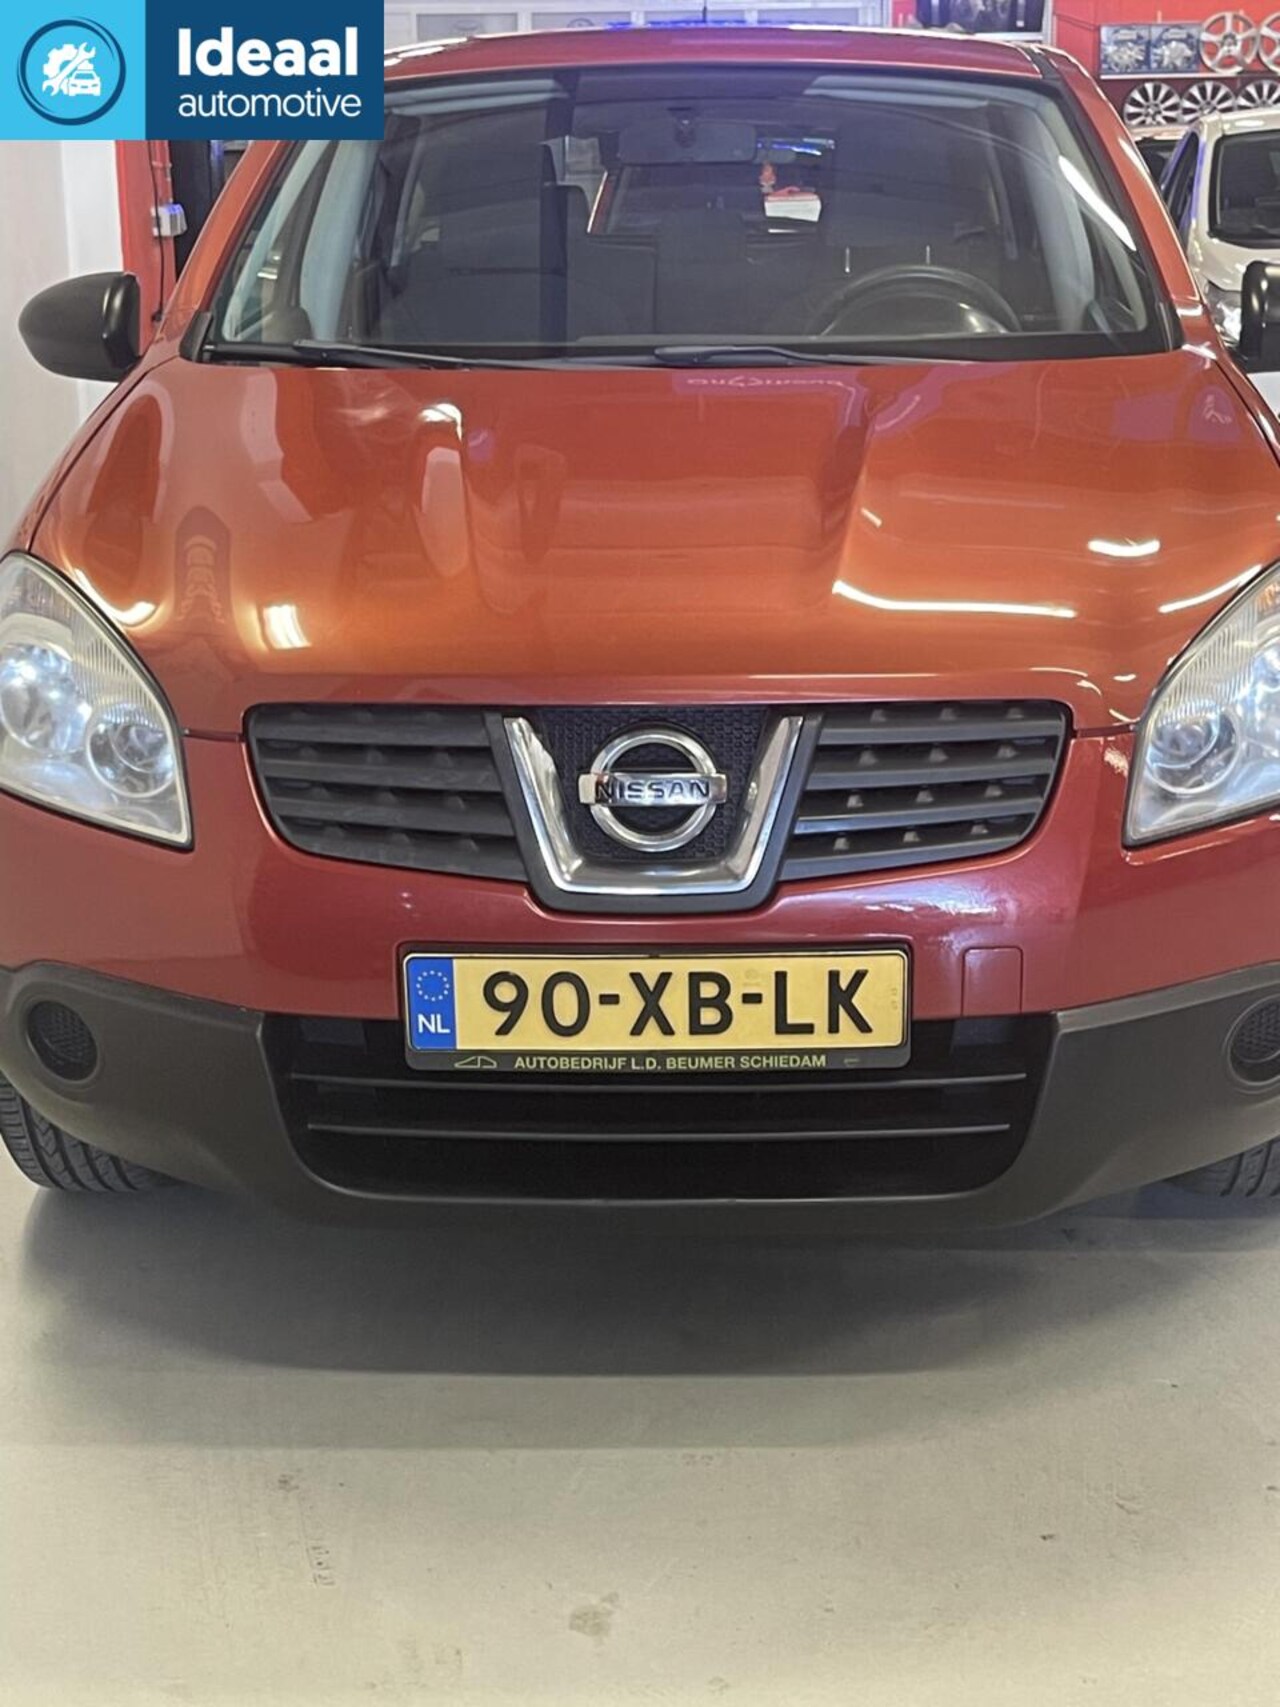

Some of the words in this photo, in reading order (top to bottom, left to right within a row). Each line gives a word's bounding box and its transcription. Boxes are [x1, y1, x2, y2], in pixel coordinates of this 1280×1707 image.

[595, 779, 710, 800] NISSAN
[483, 969, 873, 1037] 90-XB-LK
[418, 1014, 450, 1034] NL
[514, 1057, 626, 1069] AUTOBEDRIJF
[631, 1057, 662, 1069] L.D.
[666, 1057, 735, 1069] BEUMER
[740, 1055, 826, 1068] SCHIEDAM
